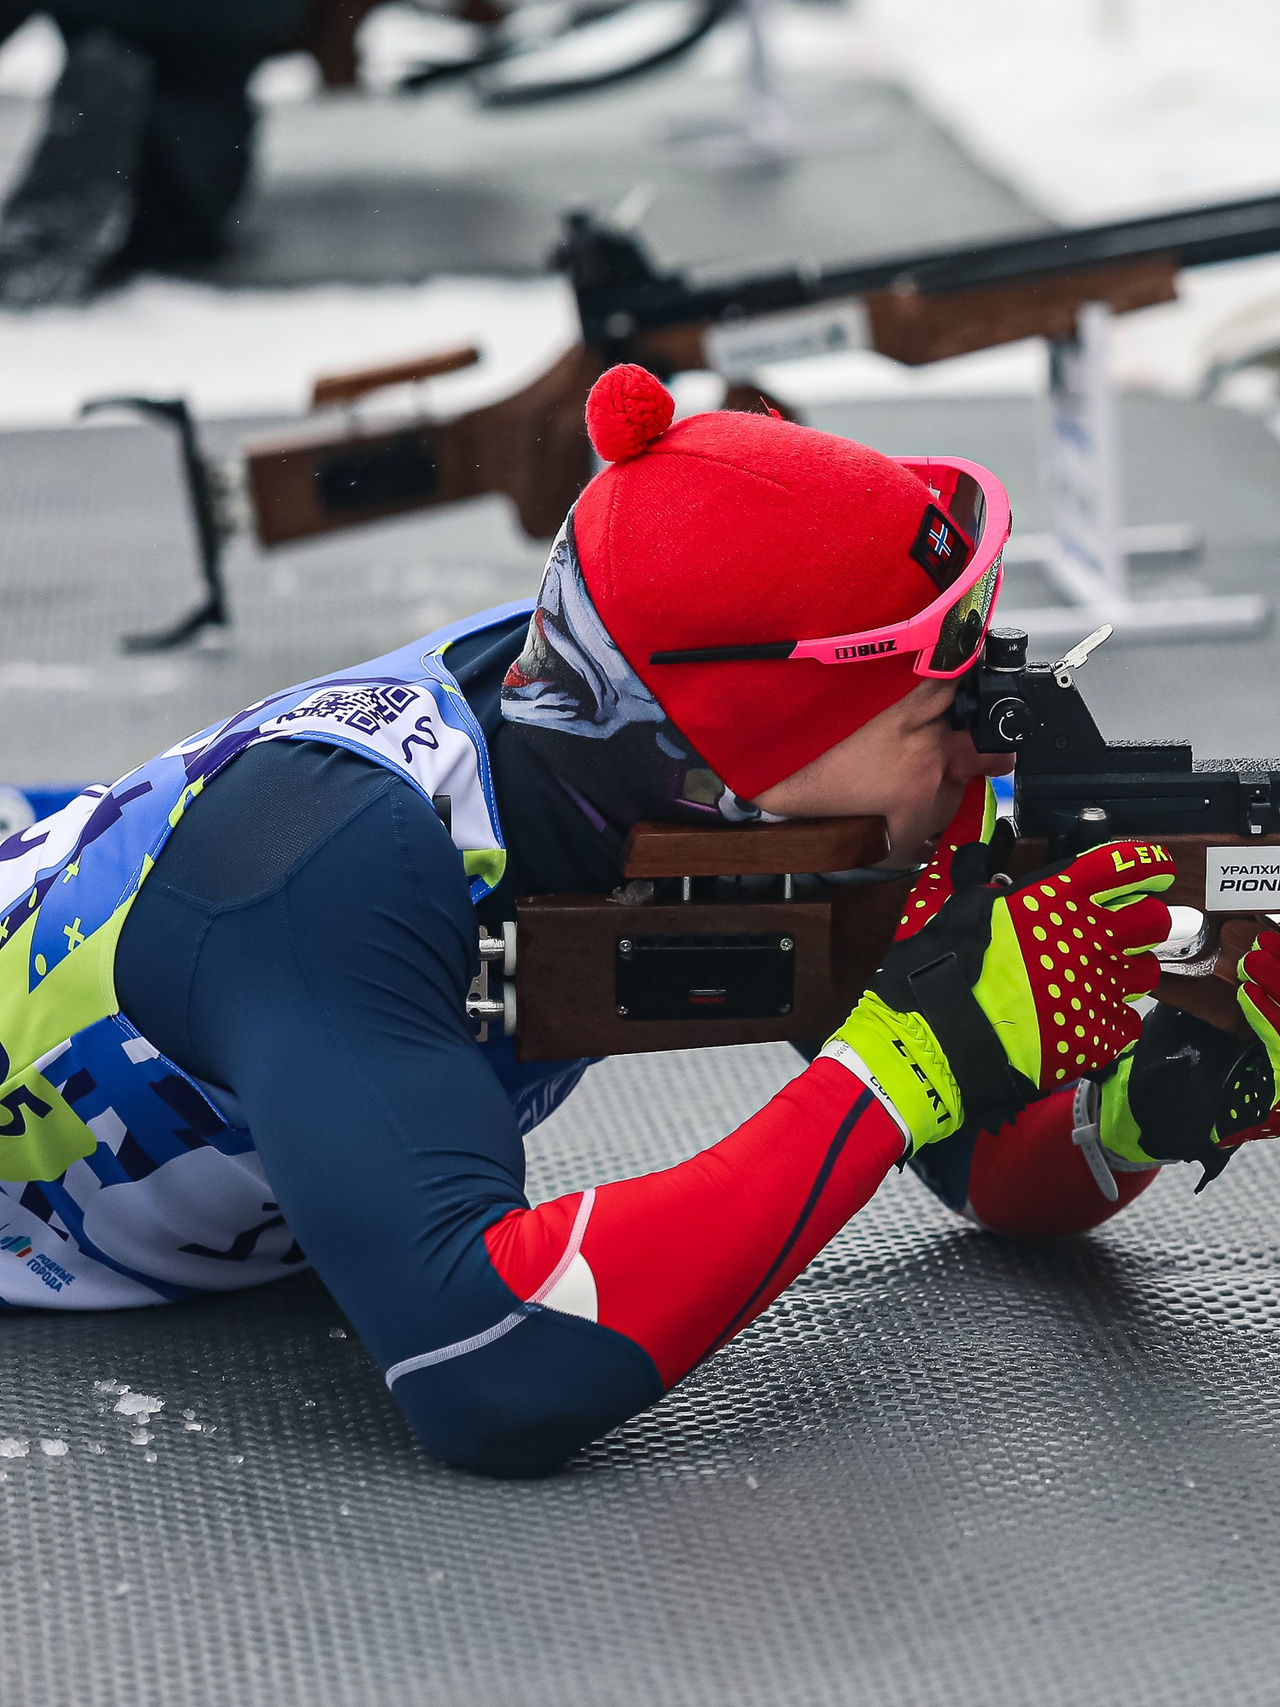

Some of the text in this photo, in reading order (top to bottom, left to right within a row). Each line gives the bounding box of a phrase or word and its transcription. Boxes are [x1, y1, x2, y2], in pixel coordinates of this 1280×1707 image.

[1111, 844, 1173, 872] LEK
[26, 1258, 63, 1293] ГОРОДА
[36, 1253, 76, 1287] РОДНЫЕ
